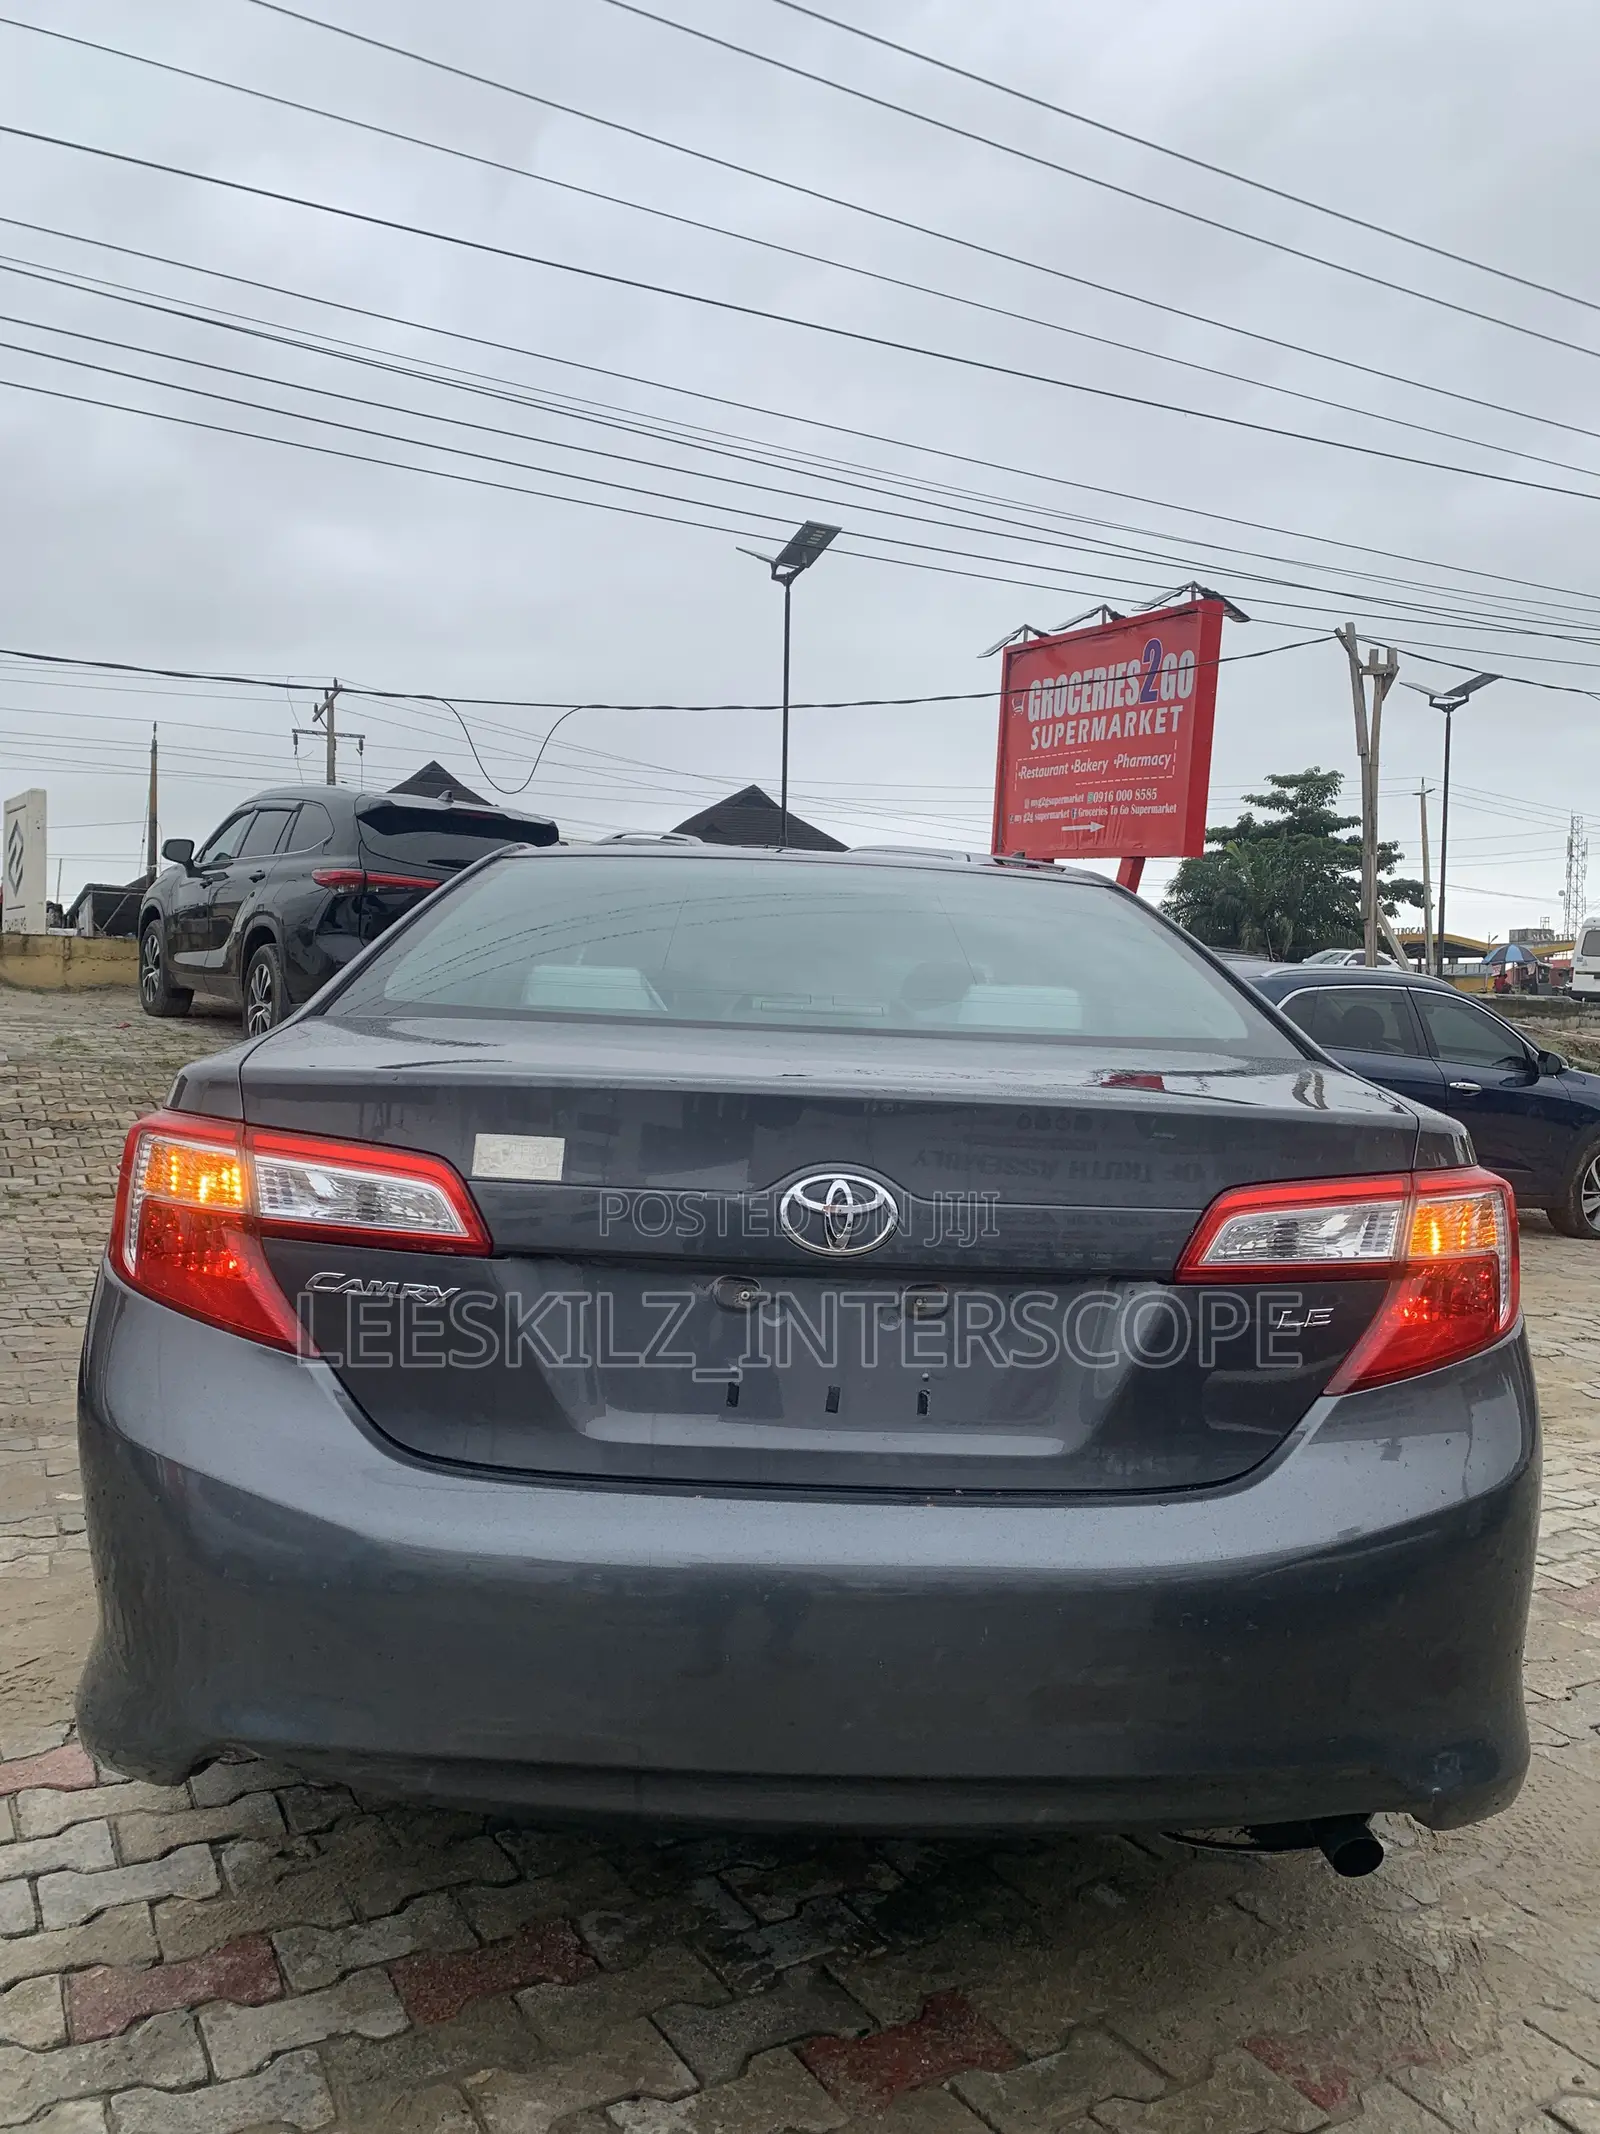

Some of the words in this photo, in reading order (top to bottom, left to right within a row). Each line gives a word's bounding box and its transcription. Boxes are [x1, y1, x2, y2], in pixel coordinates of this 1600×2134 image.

[1031, 705, 1184, 751] SUPERMARKET
[1093, 791, 1113, 804] 0916
[1116, 790, 1133, 802] 000
[1134, 788, 1157, 801] 8585
[1078, 806, 1109, 818] Groceries
[1110, 805, 1118, 815] To
[1120, 804, 1129, 815] Go
[1130, 803, 1177, 817] Supermarket
[304, 1271, 462, 1306] CAMRY
[1276, 1307, 1335, 1330] LE
